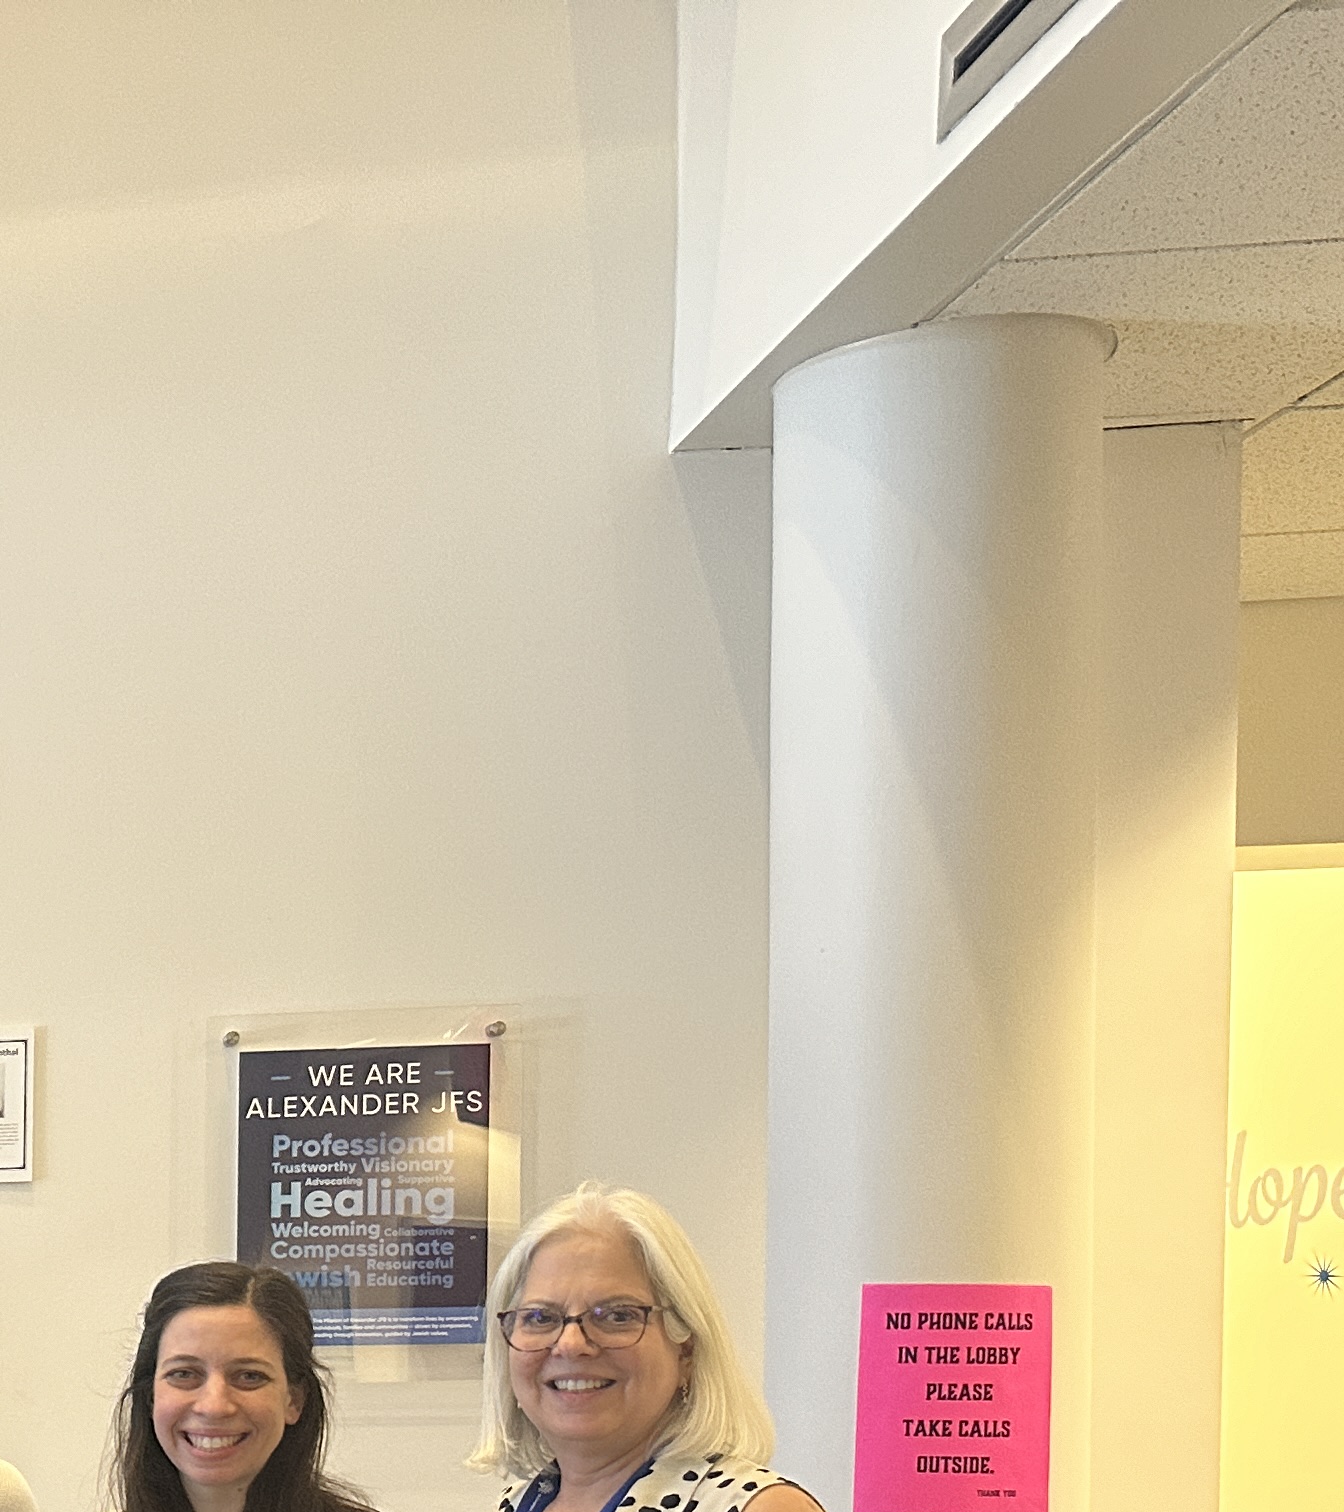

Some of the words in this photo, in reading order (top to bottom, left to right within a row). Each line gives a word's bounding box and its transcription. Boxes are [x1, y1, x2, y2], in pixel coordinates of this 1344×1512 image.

[308, 1065, 354, 1086] WE
[364, 1062, 421, 1085] ARE
[245, 1093, 419, 1119] ALEXANDER
[431, 1090, 483, 1114] JFS
[272, 1130, 454, 1158] Professional
[272, 1160, 356, 1175] Trustworthy
[361, 1156, 454, 1174] Visionary
[304, 1175, 363, 1187] Advocating
[398, 1174, 455, 1186] Supportive
[270, 1178, 455, 1225] Healing
[271, 1220, 381, 1239] Welcoming
[384, 1227, 454, 1237] Collaborative
[270, 1238, 454, 1262] Compassionate
[366, 1256, 454, 1271] Resourceful
[366, 1271, 454, 1288] Educating
[886, 1312, 911, 1330] NO
[917, 1312, 979, 1330] PHONE
[984, 1313, 1033, 1330] CALLS
[898, 1346, 918, 1364] IN
[925, 1346, 960, 1364] THE
[966, 1346, 1021, 1364] LOBBY
[925, 1383, 994, 1401] PLEASE
[903, 1419, 953, 1437] TAKE
[958, 1420, 1011, 1437] CALLS
[916, 1456, 995, 1474] OUTSIDE.
[977, 1489, 1000, 1497] THANK
